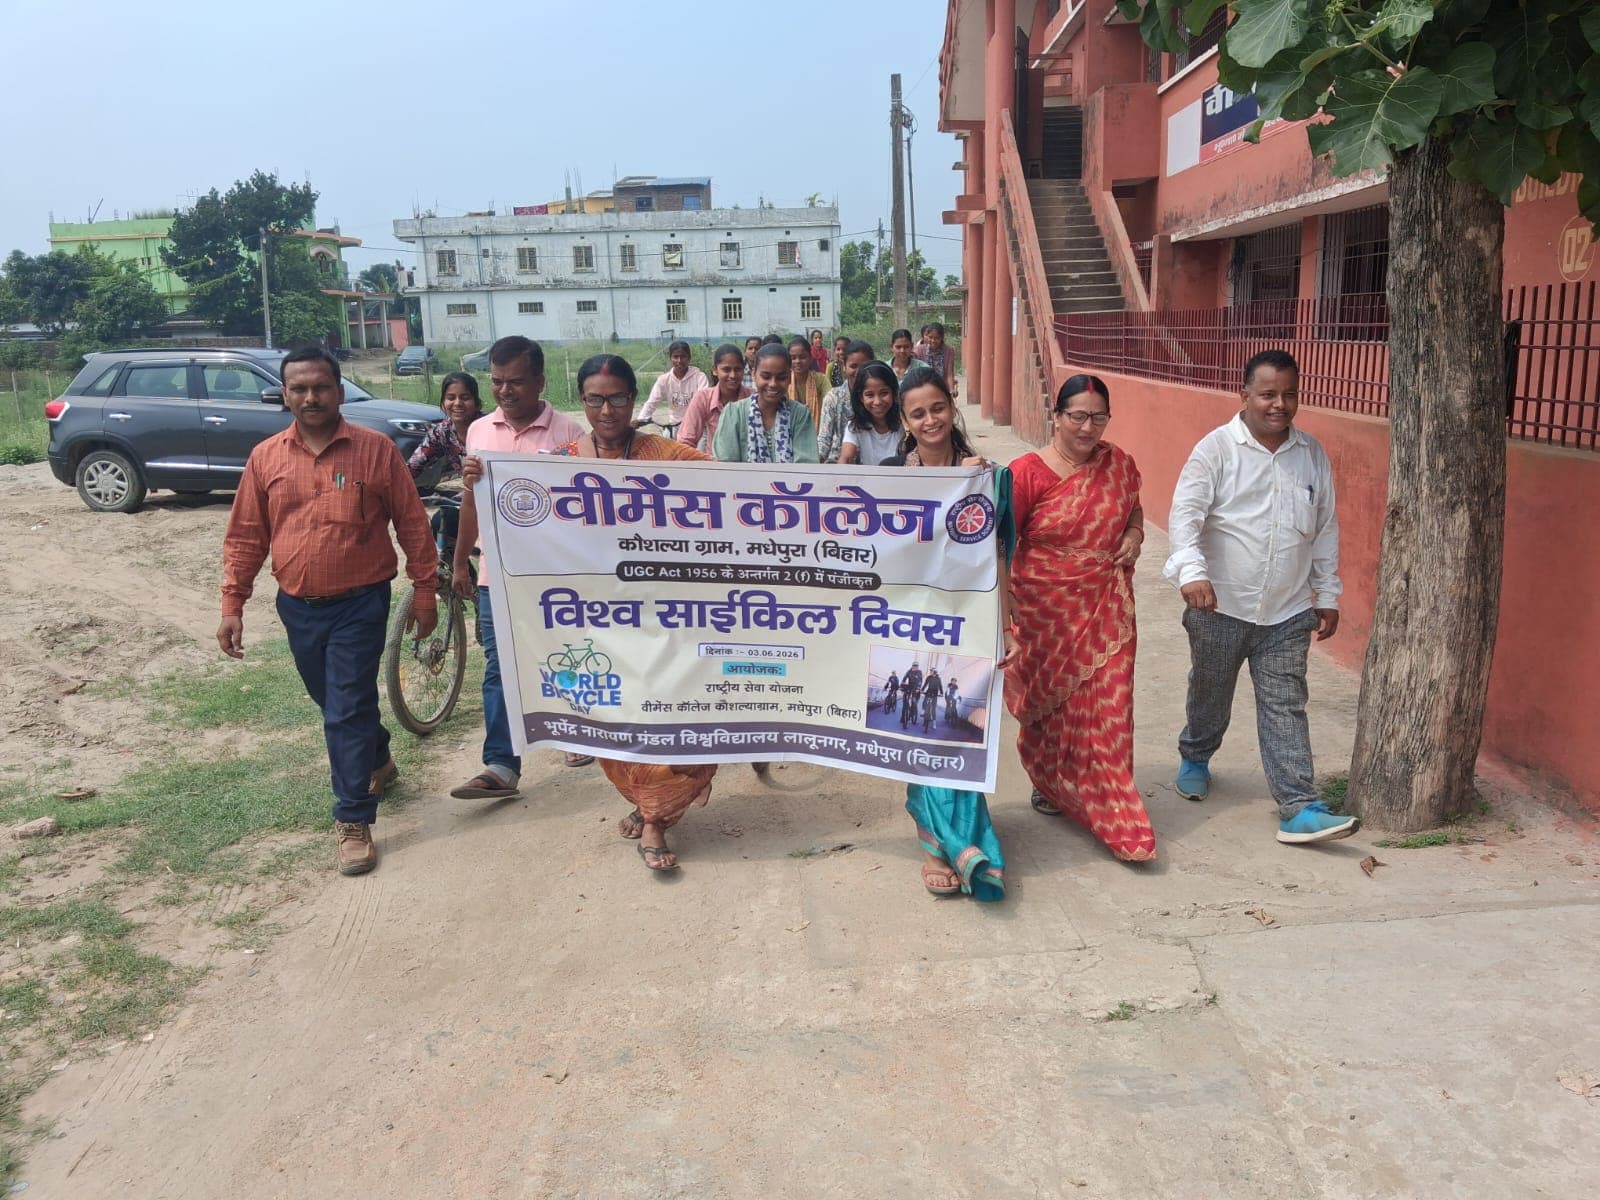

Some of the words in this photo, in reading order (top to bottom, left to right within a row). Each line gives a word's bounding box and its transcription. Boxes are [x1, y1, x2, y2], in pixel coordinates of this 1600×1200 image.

[1562, 226, 1591, 274] 02
[548, 472, 726, 529] वीमेंस
[733, 481, 942, 544] कॉलेज
[617, 533, 690, 553] कौशल्या
[746, 538, 807, 563] मधेपुरा
[814, 540, 878, 568] (बिहार)
[624, 566, 654, 577] UGC
[659, 566, 680, 577] Act
[686, 568, 717, 578] 1956
[720, 565, 734, 579] के
[784, 571, 791, 580] 2
[794, 570, 810, 584] (f)
[814, 569, 824, 583] में
[827, 572, 874, 589] पंजीकृत
[539, 587, 644, 629] विश्व
[654, 589, 841, 634] साईकिल
[849, 595, 966, 646] दिवस
[706, 646, 733, 656] दिनांक
[748, 649, 799, 658] 03.06.2026
[541, 683, 622, 706] BICYCLE
[705, 680, 740, 694] राष्ट्रीय
[744, 680, 764, 692] सेवा
[769, 682, 804, 694] योजना
[642, 700, 673, 712] वीमेंस
[676, 700, 710, 712] कॉलेज
[786, 700, 822, 716] मधेपुरा
[826, 704, 862, 722] (बिहार)
[544, 718, 578, 736] भूपेंद्र
[580, 724, 632, 744] नारायण
[636, 730, 676, 746] मंडल
[680, 728, 780, 748] विश्वविद्यालय
[784, 732, 851, 754] लालूनगर,
[855, 740, 903, 763] मधेपुरा
[906, 748, 965, 772] (बिहार)
